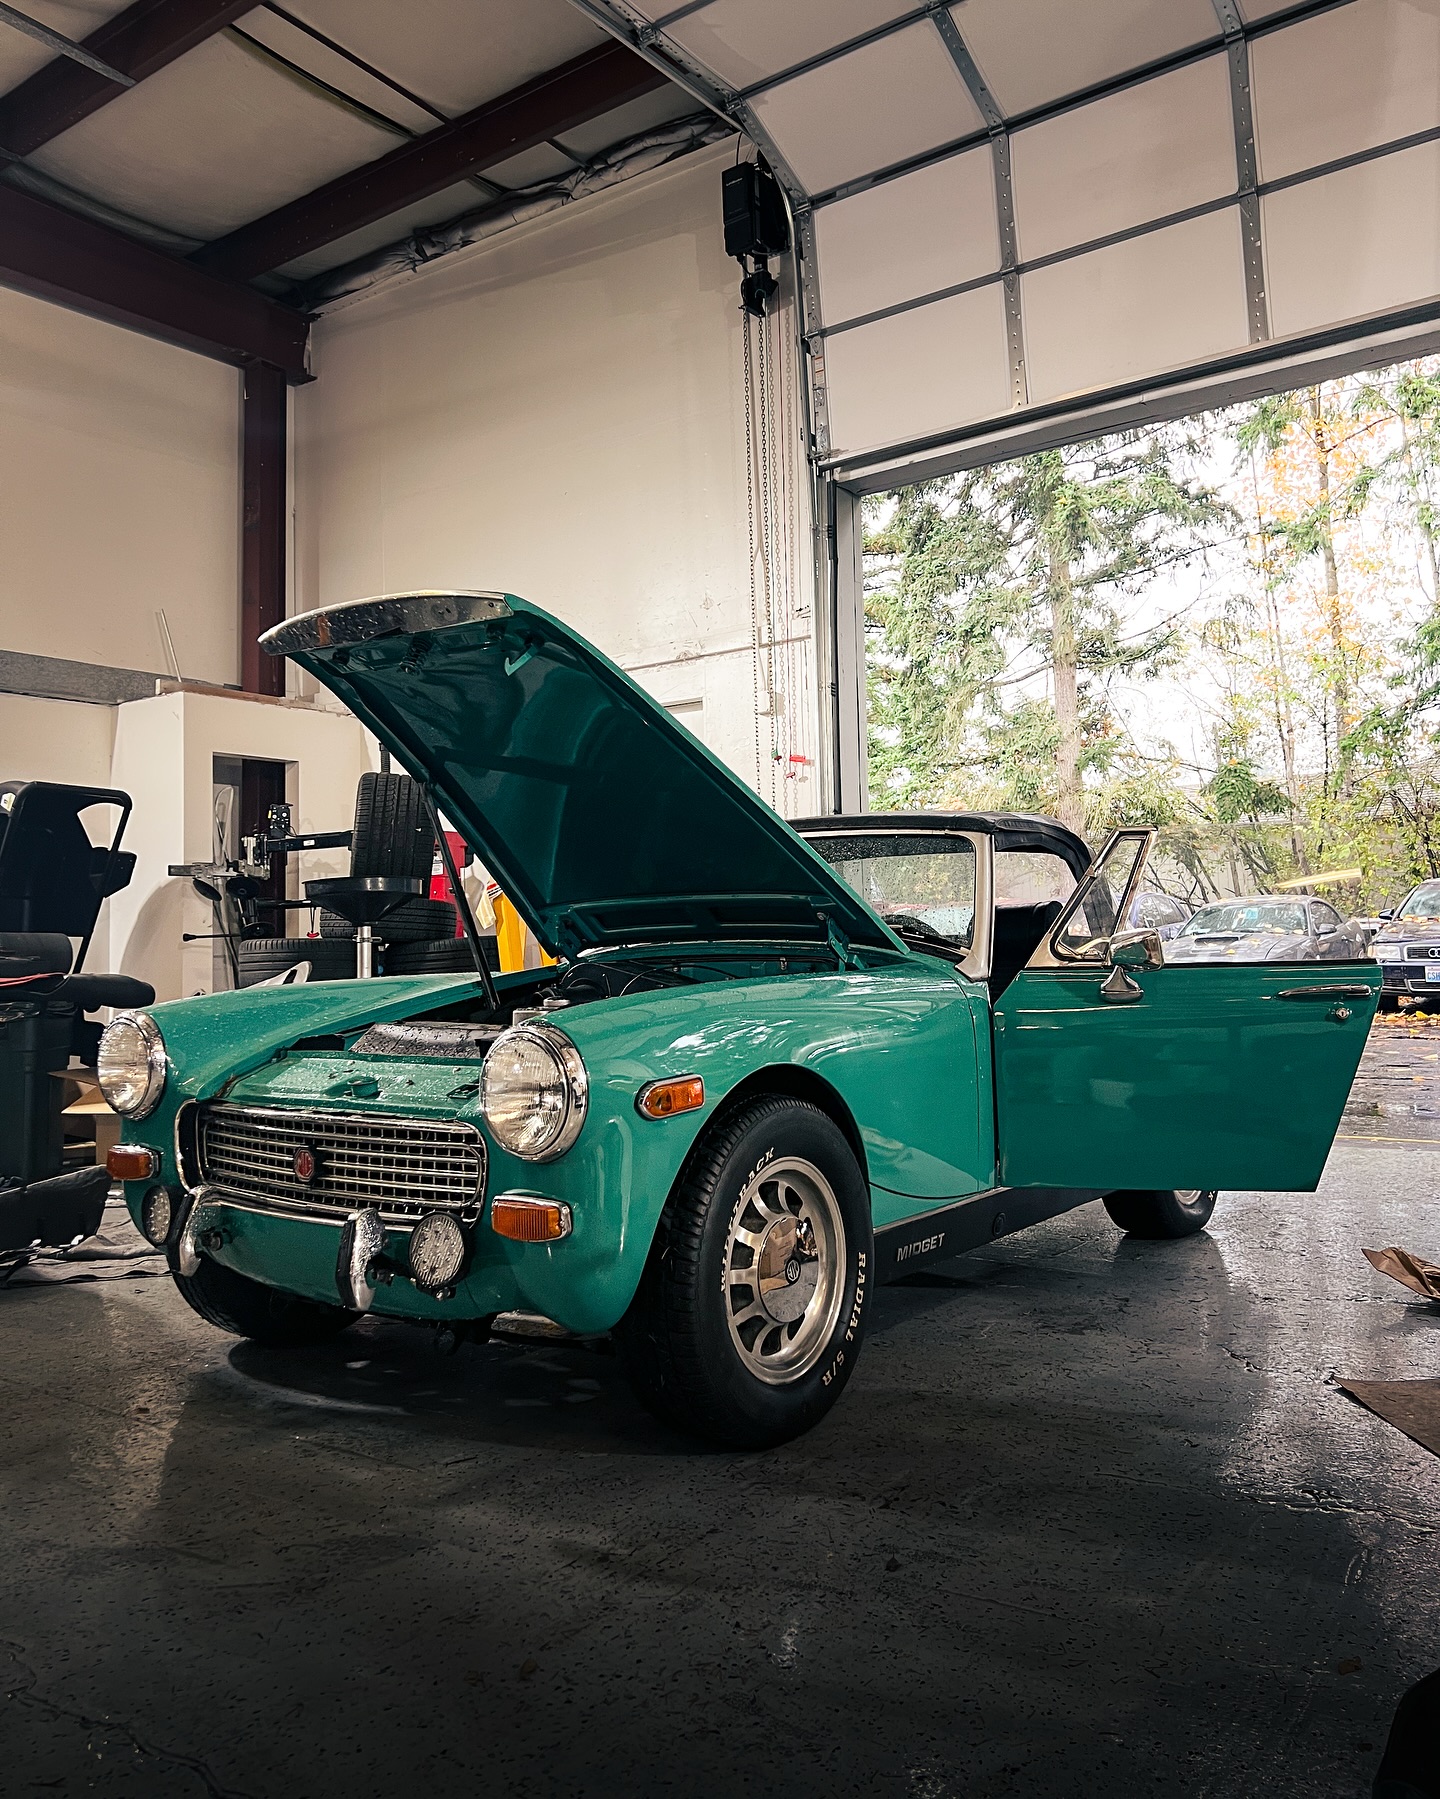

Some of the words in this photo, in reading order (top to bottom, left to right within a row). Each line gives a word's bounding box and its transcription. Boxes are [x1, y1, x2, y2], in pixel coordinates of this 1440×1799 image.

[896, 1232, 945, 1262] MIDGET
[845, 1251, 866, 1341] RADIAL
[822, 1350, 845, 1386] S/R
